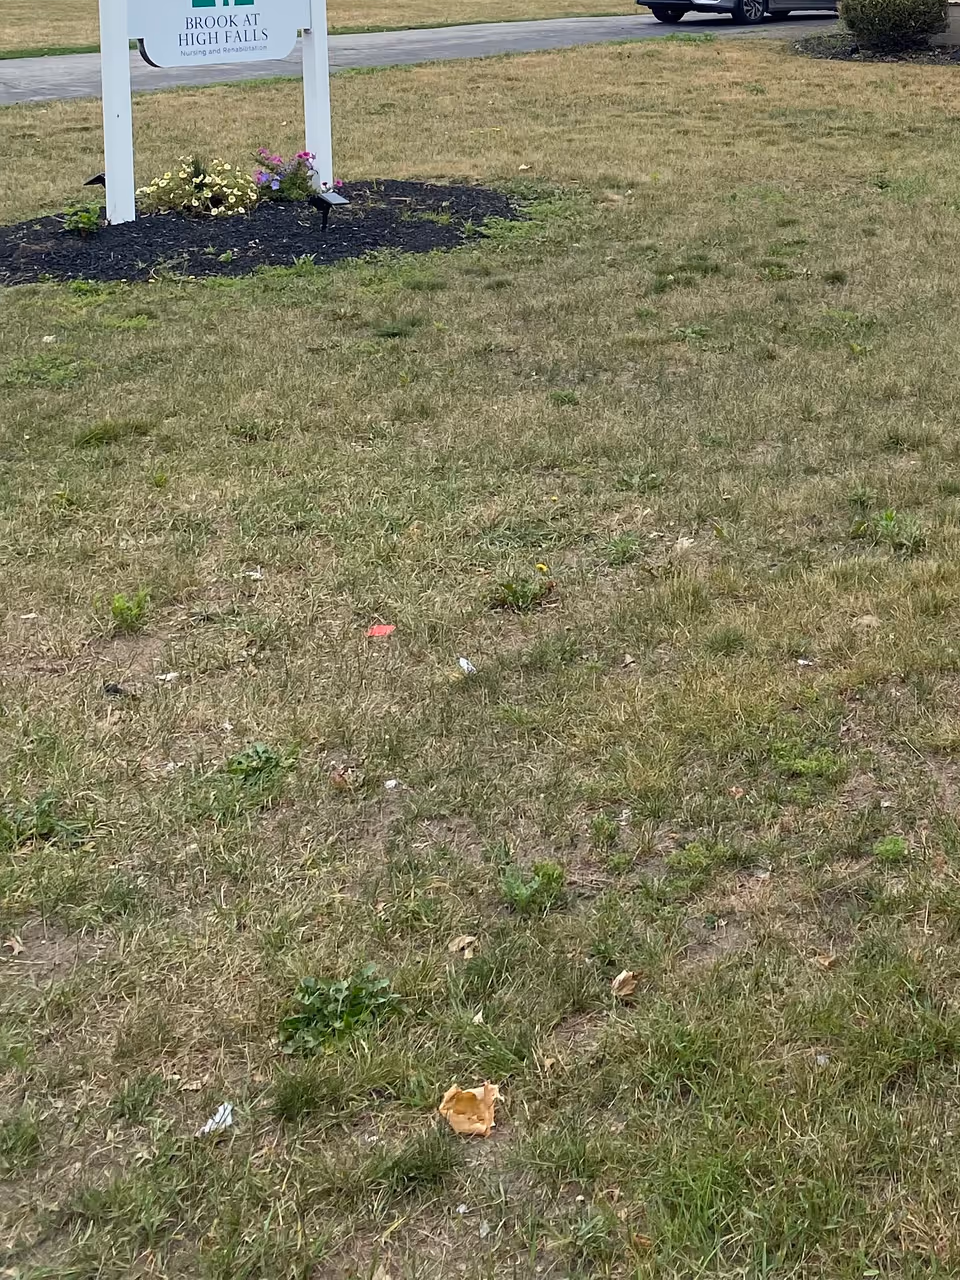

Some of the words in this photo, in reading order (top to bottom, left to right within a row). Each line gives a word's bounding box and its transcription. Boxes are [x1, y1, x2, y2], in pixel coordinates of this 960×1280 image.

[185, 15, 238, 30] BROOK
[242, 13, 260, 27] AT
[178, 31, 218, 46] HIGH
[224, 28, 268, 43] FALLS
[180, 49, 207, 57] Nursing
